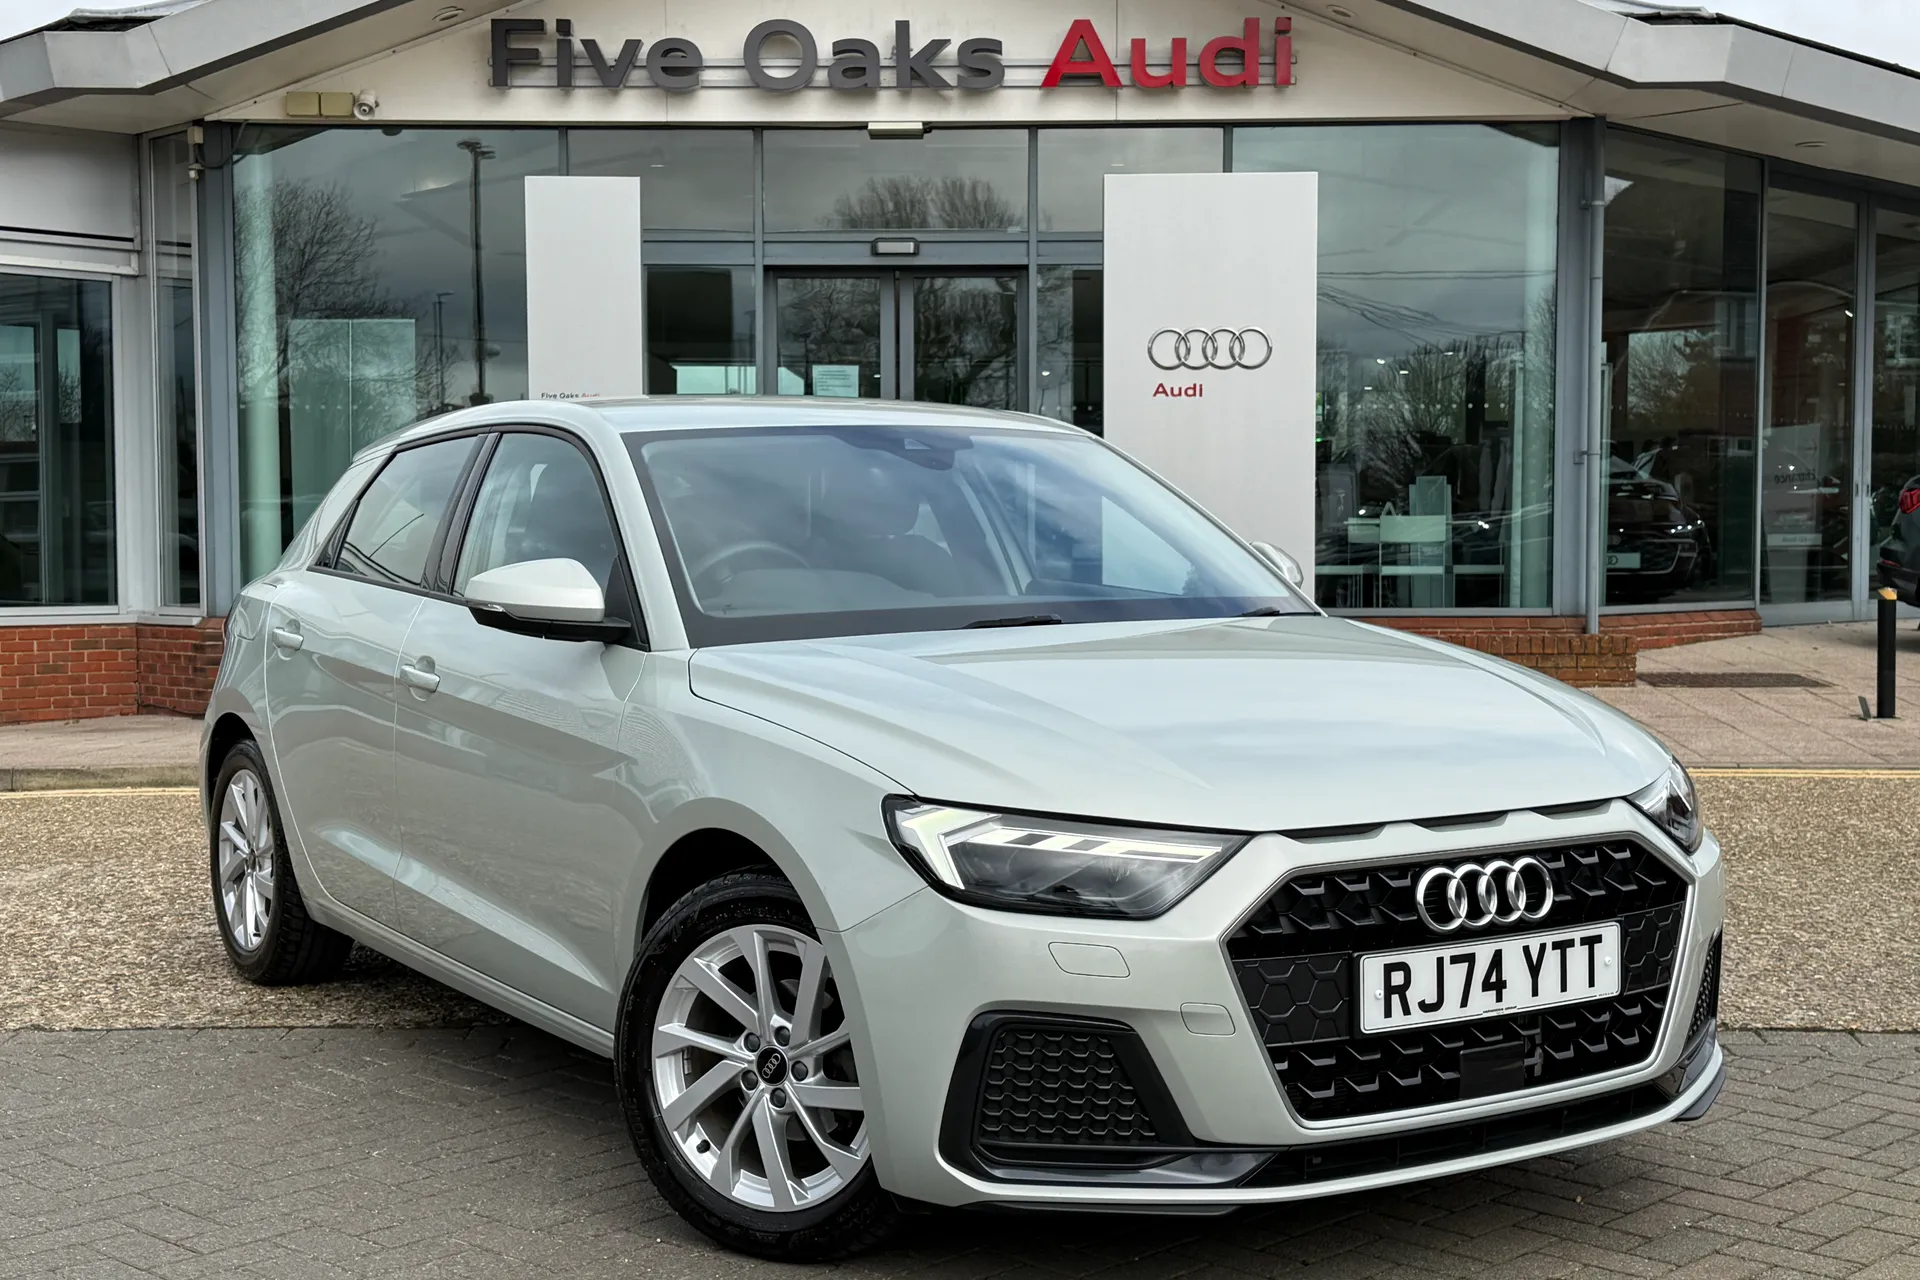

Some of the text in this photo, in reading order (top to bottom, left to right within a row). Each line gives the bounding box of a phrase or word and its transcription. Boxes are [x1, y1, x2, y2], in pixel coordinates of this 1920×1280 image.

[490, 17, 1293, 91] Five Oaks Audi
[1153, 383, 1203, 397] Audi
[1383, 934, 1603, 1019] RJ74 YTT
